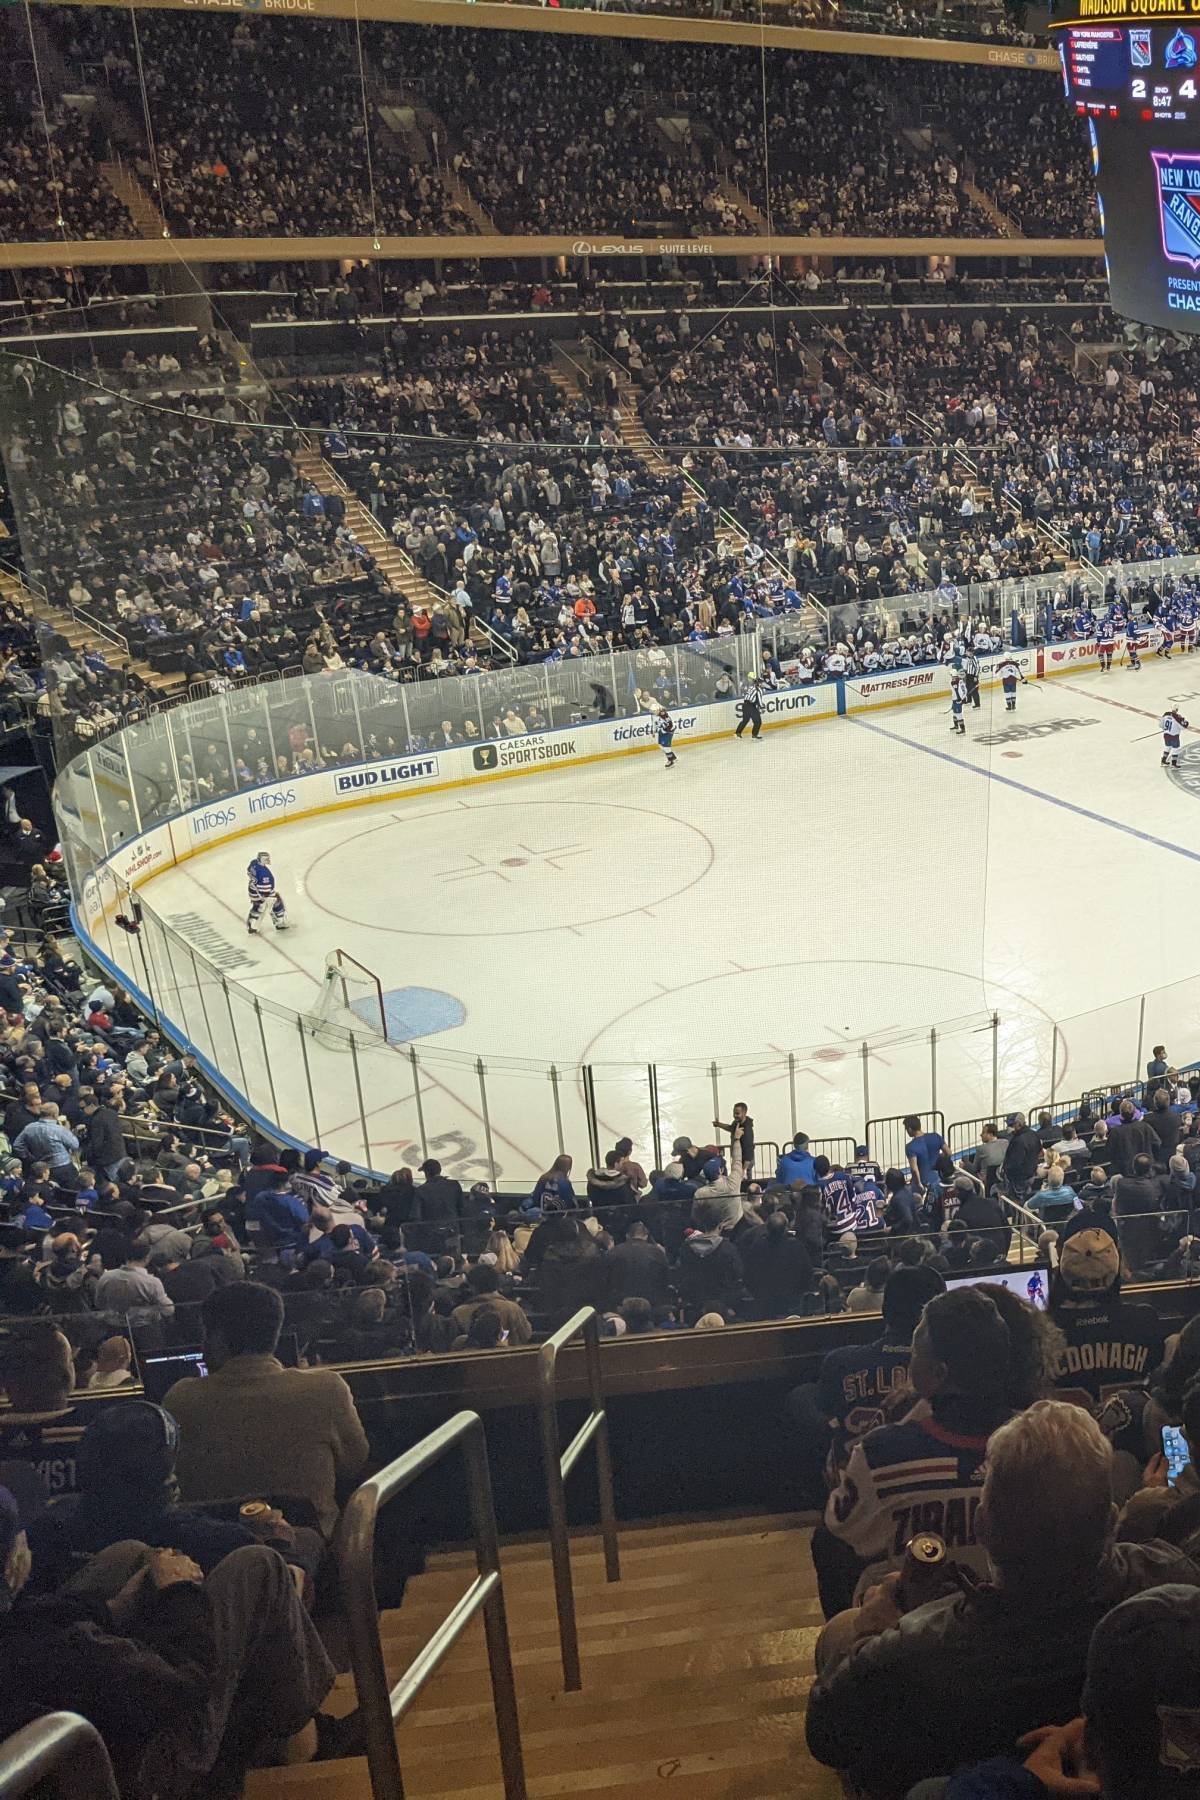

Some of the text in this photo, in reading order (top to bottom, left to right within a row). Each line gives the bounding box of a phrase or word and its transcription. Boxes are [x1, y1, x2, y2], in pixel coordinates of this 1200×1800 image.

[988, 50, 1024, 63] CHASE
[1132, 80, 1146, 98] 2
[1179, 80, 1197, 99] 4
[1153, 96, 1171, 107] 8:47
[1160, 167, 1184, 188] NEW
[592, 245, 714, 254] LEXUS SUITE LEVEL
[1163, 719, 1172, 732] 91
[499, 736, 545, 751] CAESARS
[500, 741, 577, 767] SPORTSBOOK
[339, 760, 434, 791] BUD LIGHT
[248, 788, 297, 815] Infosys
[193, 806, 237, 836] Infosys
[856, 1199, 879, 1229] 21
